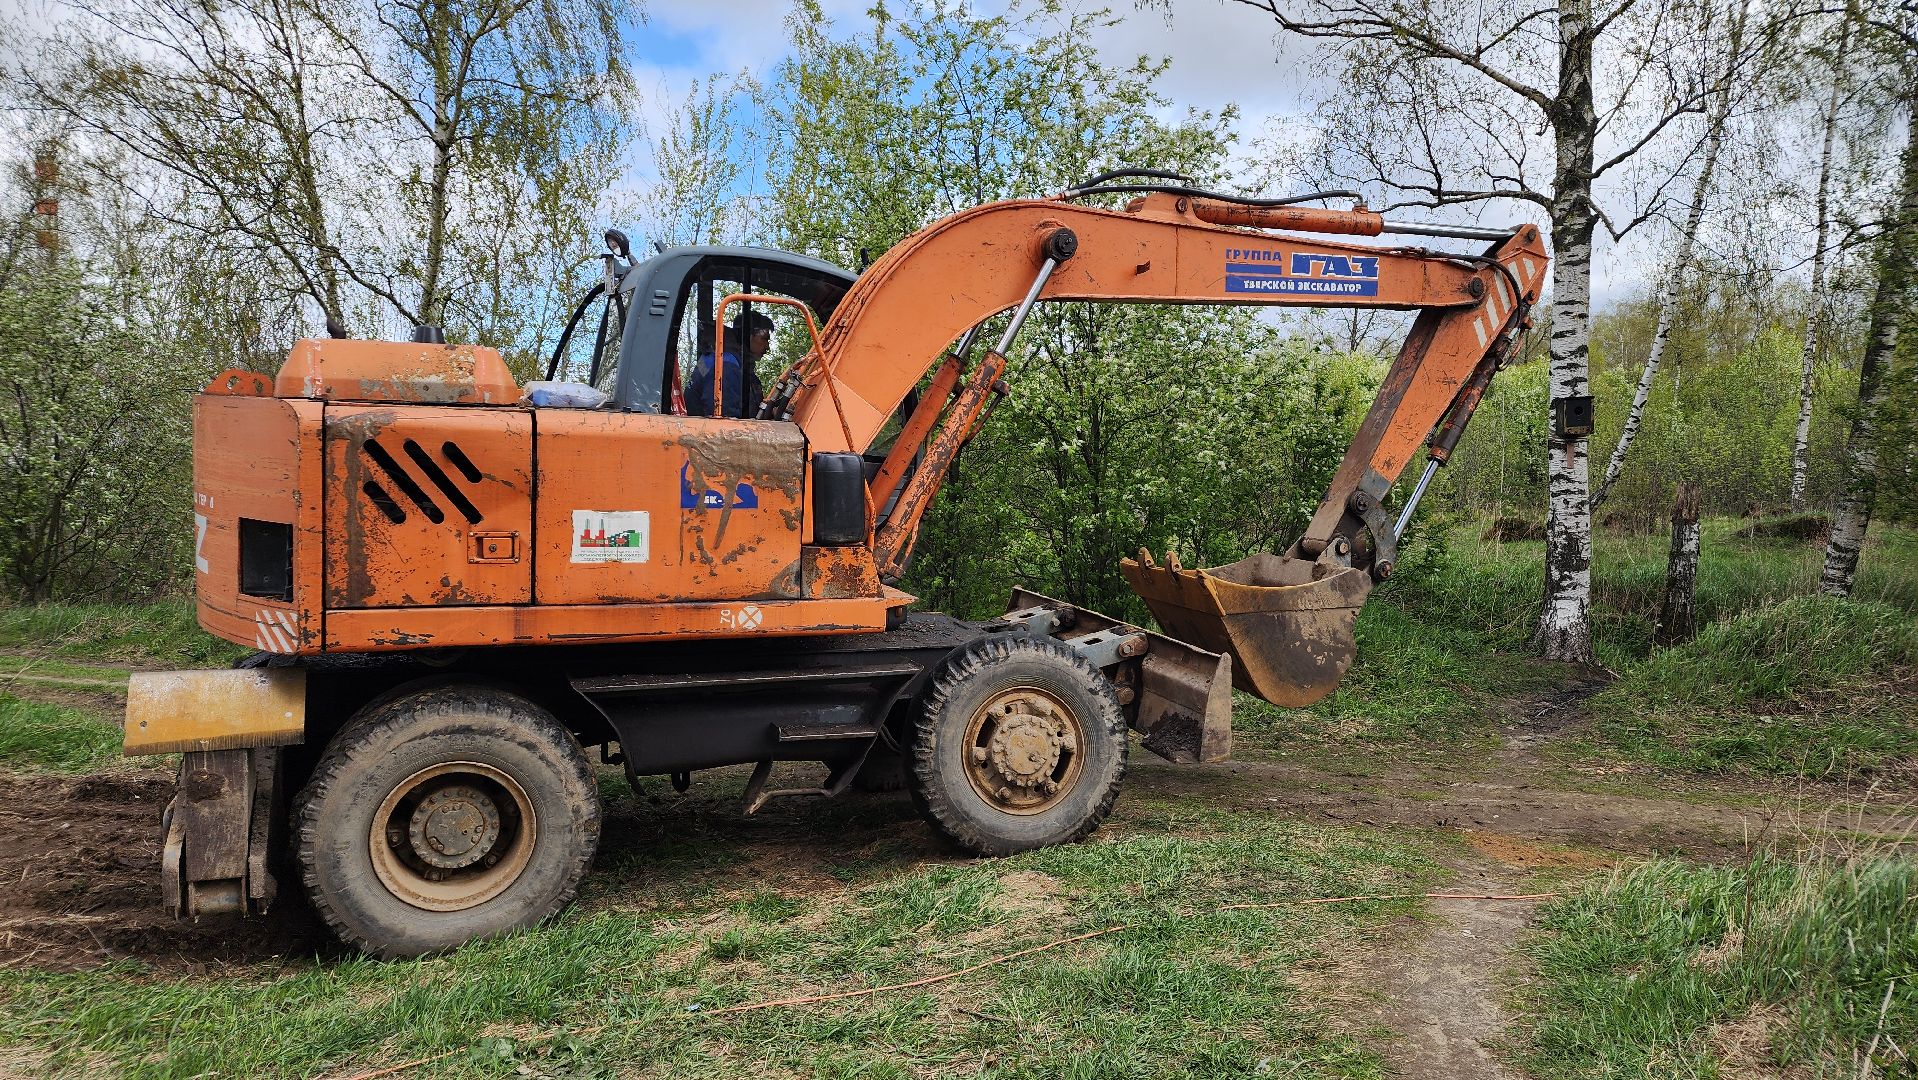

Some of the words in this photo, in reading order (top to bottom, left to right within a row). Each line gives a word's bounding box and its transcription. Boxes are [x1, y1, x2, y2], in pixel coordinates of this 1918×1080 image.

[1225, 249, 1282, 262] ГРУППА
[1291, 252, 1379, 279] ГАЗ
[1243, 279, 1295, 291] ТВЕРСКОЙ
[1297, 282, 1362, 293] ЭКСКАВАТОР
